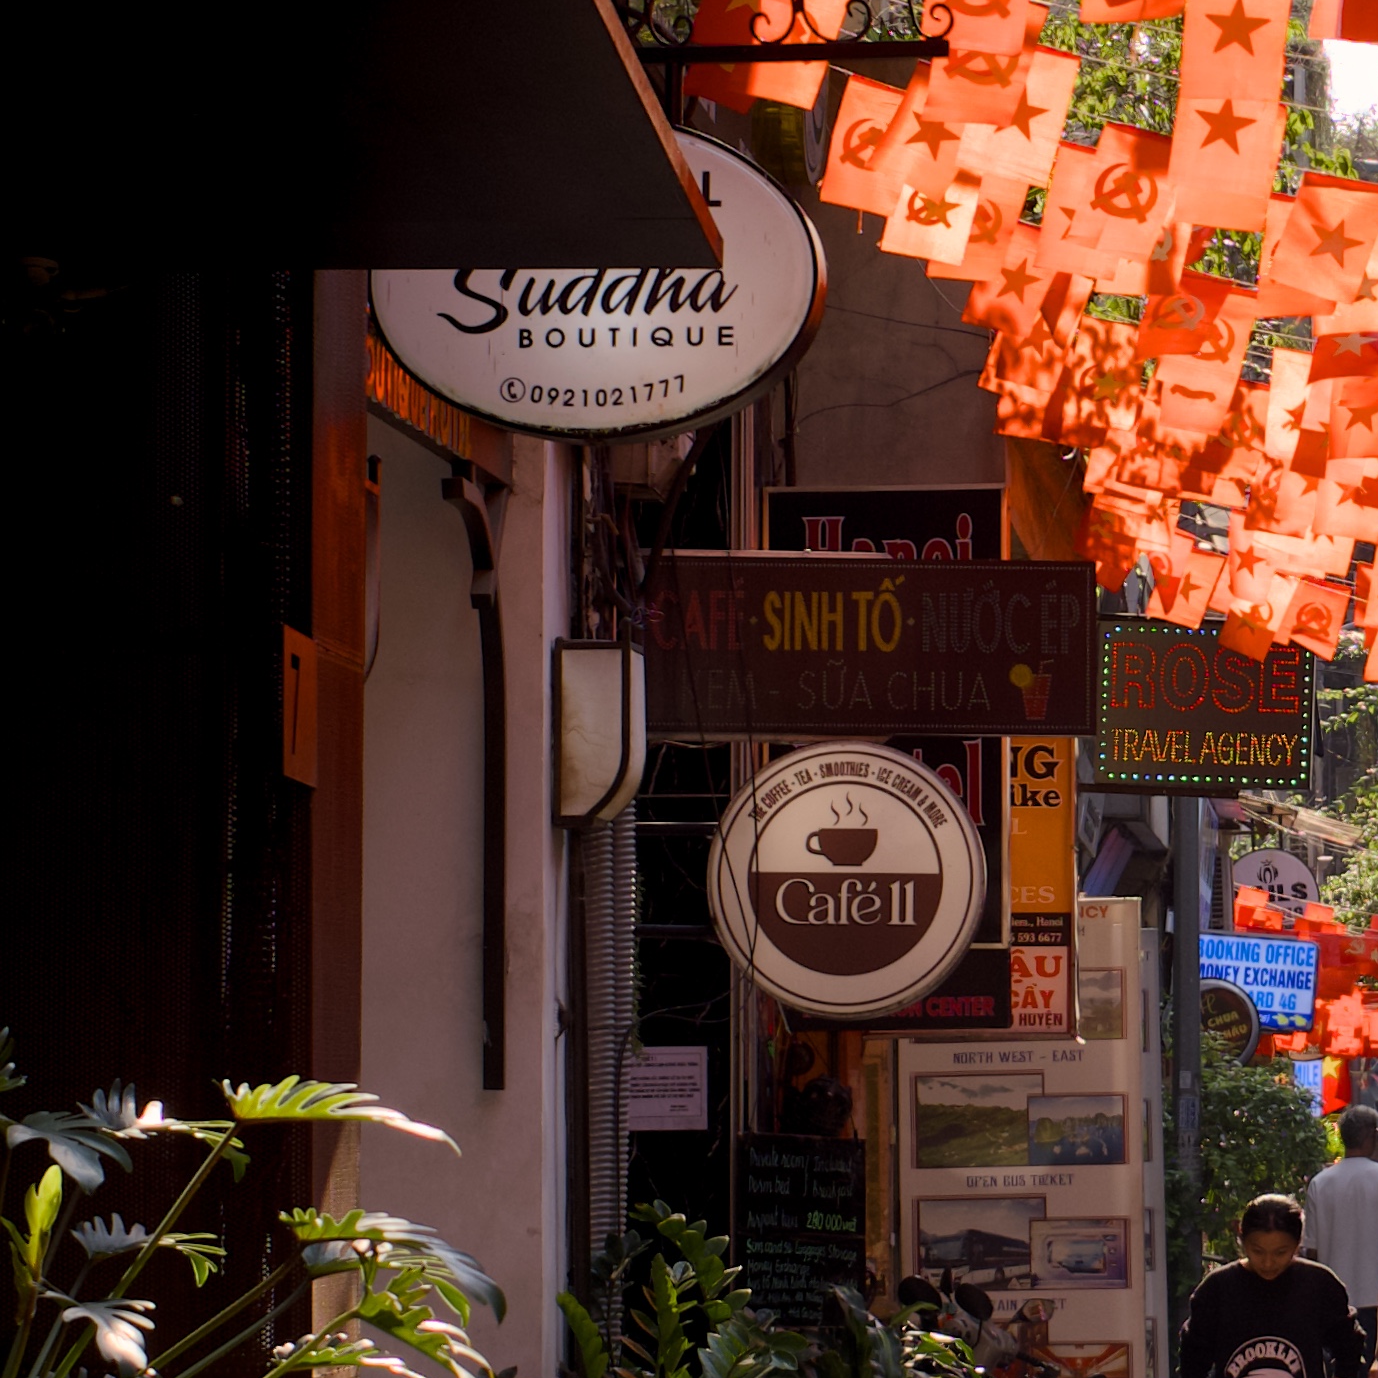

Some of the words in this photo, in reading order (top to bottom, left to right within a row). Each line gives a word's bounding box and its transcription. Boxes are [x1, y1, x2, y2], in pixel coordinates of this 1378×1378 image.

[518, 326, 734, 348] BOUTIQUE
[530, 374, 686, 407] 0921021777
[651, 577, 744, 651] CAFÉ
[762, 590, 845, 653] SINH
[851, 574, 906, 653] TỐ
[921, 579, 1032, 654] NƯỚC
[797, 658, 874, 711] SỮA
[887, 669, 991, 712] CHUA
[1110, 641, 1300, 714] ROSE
[1111, 728, 1197, 763] TRAVEL
[1200, 731, 1299, 766] AGENCY
[748, 802, 767, 822] THE
[760, 780, 792, 809] COFFEE
[794, 769, 813, 787] TEA
[818, 761, 870, 779] SMOOTHIES
[876, 767, 893, 785] ICE
[891, 774, 924, 802] CREAM
[923, 801, 948, 829] MORE
[1265, 944, 1315, 967] OFFICE
[1243, 967, 1312, 990] EXCHANGE
[926, 996, 996, 1018] CENTER
[1279, 993, 1298, 1010] 4G
[953, 1051, 993, 1064] NORTH
[999, 1051, 1033, 1064] WEST
[1052, 1050, 1085, 1062] EAST
[966, 1175, 998, 1188] OPEN
[1003, 1175, 1026, 1187] BUS
